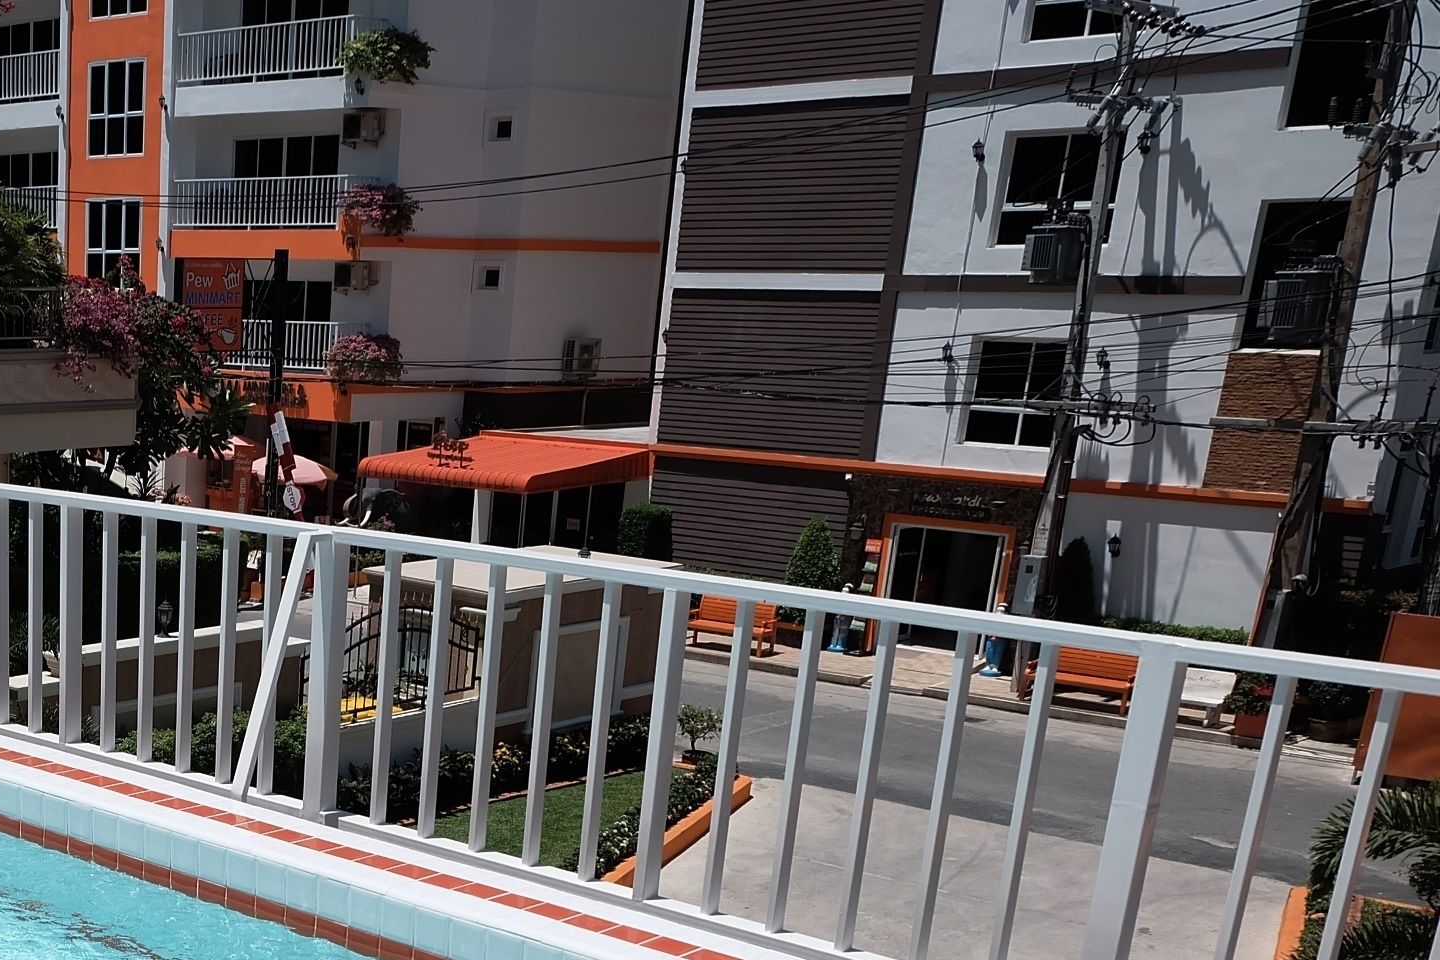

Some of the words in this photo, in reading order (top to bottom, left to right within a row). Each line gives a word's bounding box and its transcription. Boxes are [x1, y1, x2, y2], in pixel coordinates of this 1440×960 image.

[186, 272, 213, 288] Pew
[185, 292, 240, 305] MINIMART
[286, 486, 297, 508] STOP
